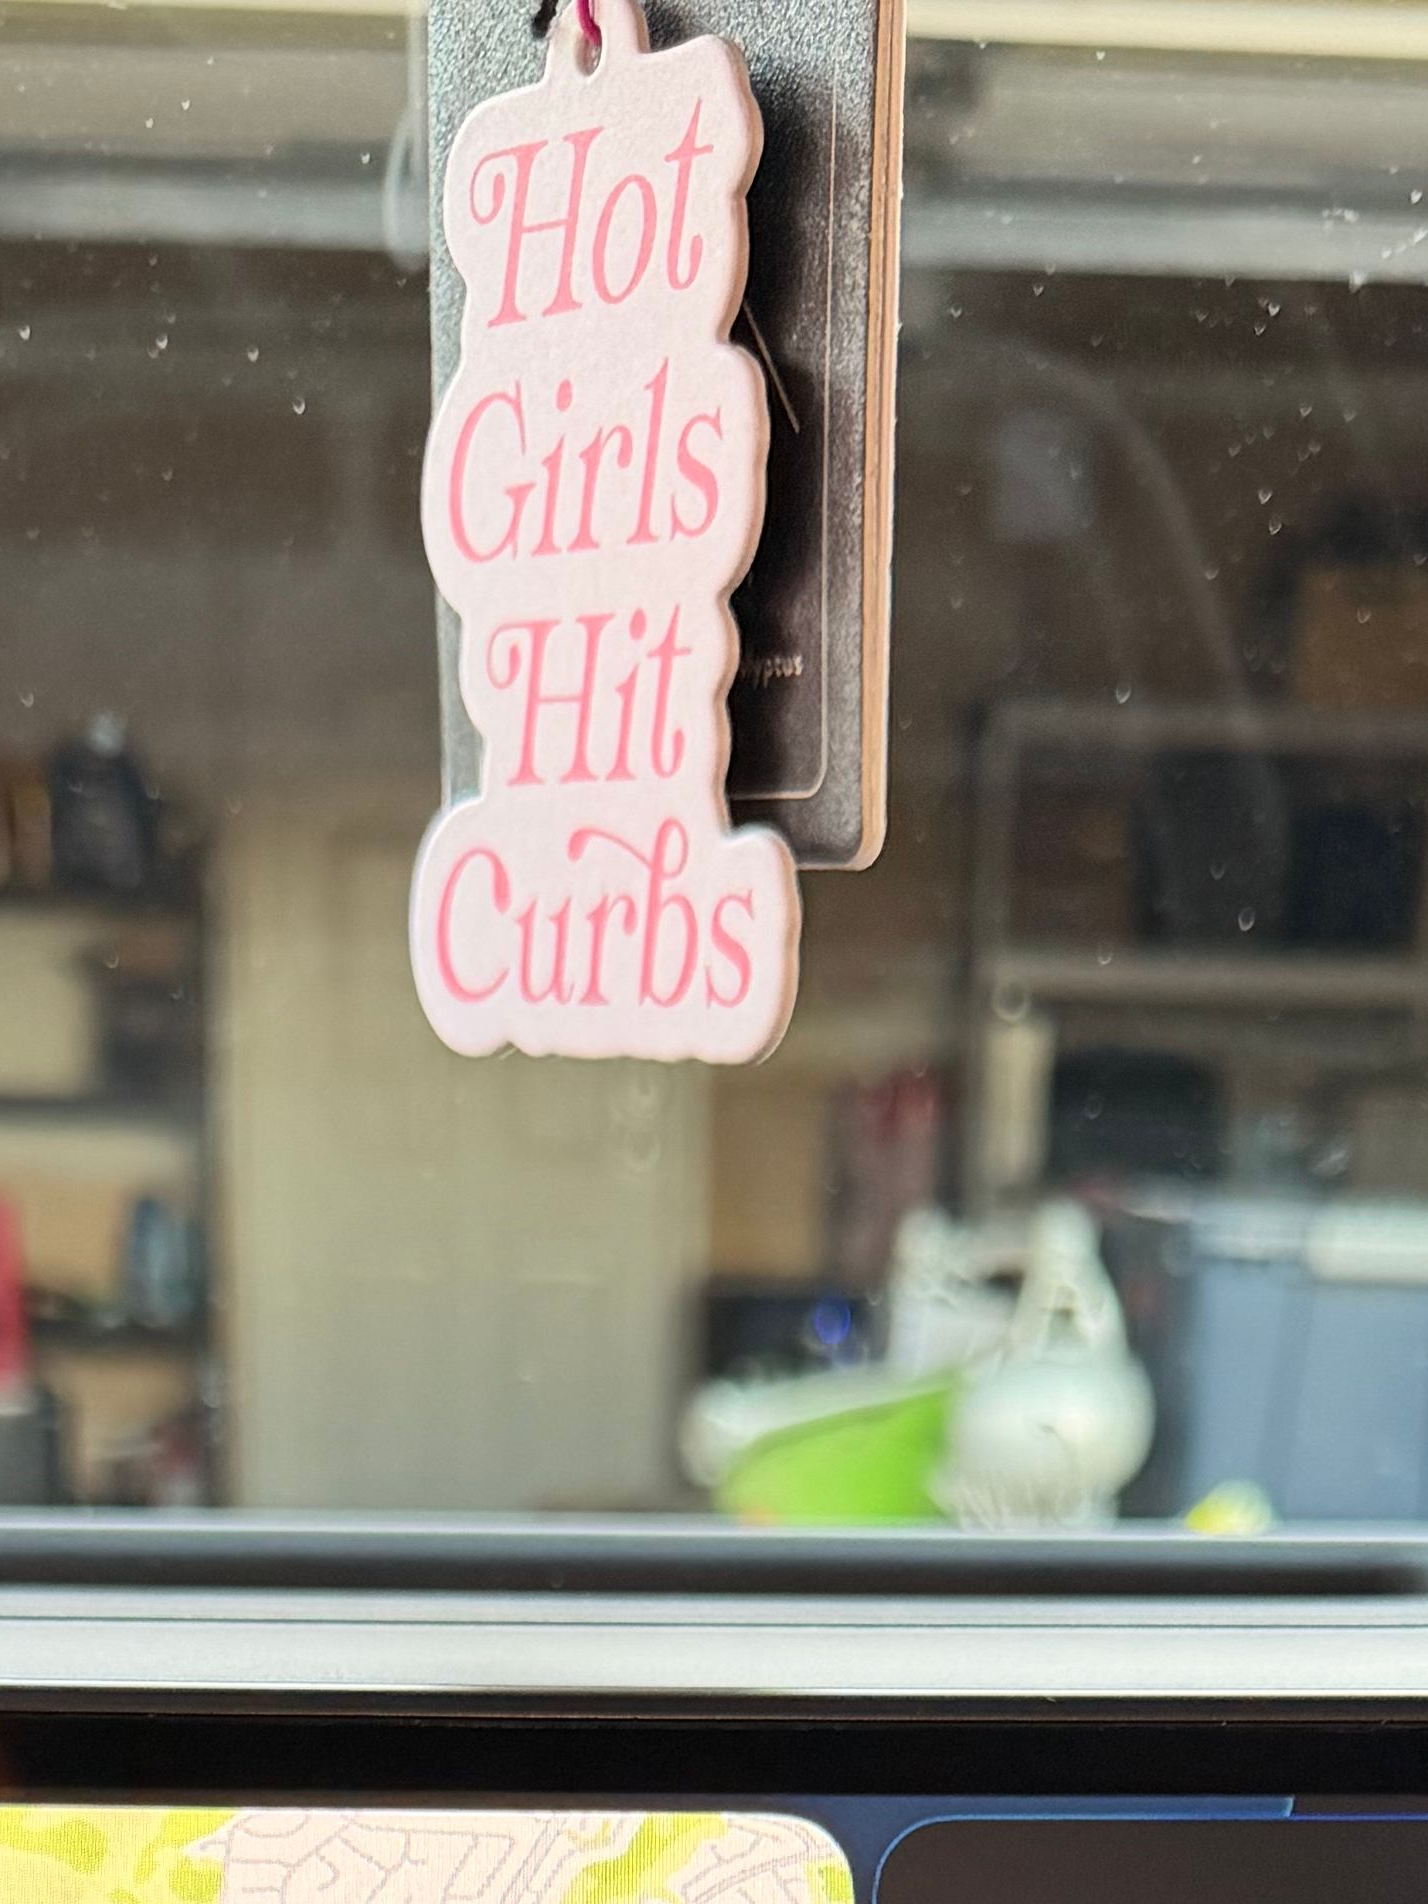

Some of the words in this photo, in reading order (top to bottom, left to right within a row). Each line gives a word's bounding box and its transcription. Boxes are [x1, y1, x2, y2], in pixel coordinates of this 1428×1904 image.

[469, 98, 714, 329] Hot
[448, 357, 723, 563] Girls
[486, 602, 694, 786] Hit
[437, 818, 754, 1010] Curbs
